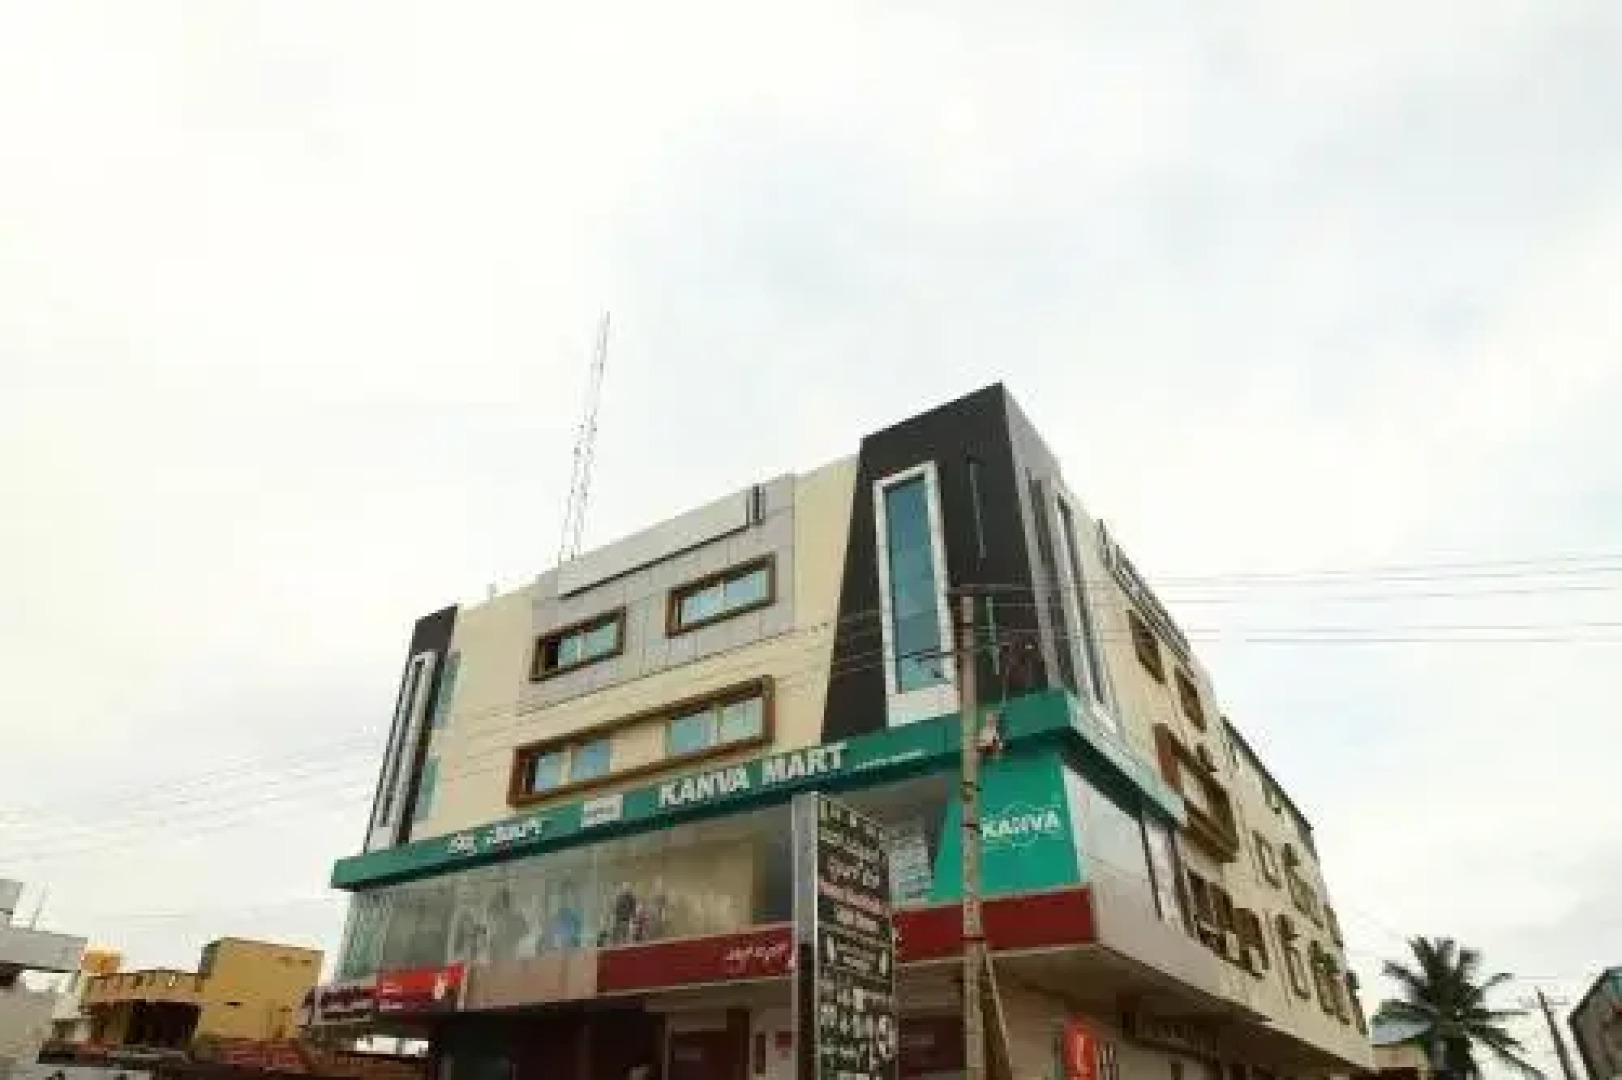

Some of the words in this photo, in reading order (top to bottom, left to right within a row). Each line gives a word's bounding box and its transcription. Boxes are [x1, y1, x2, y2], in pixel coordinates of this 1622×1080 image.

[659, 767, 750, 809] KANVA
[762, 742, 847, 786] MART
[980, 808, 1061, 840] KANVA
